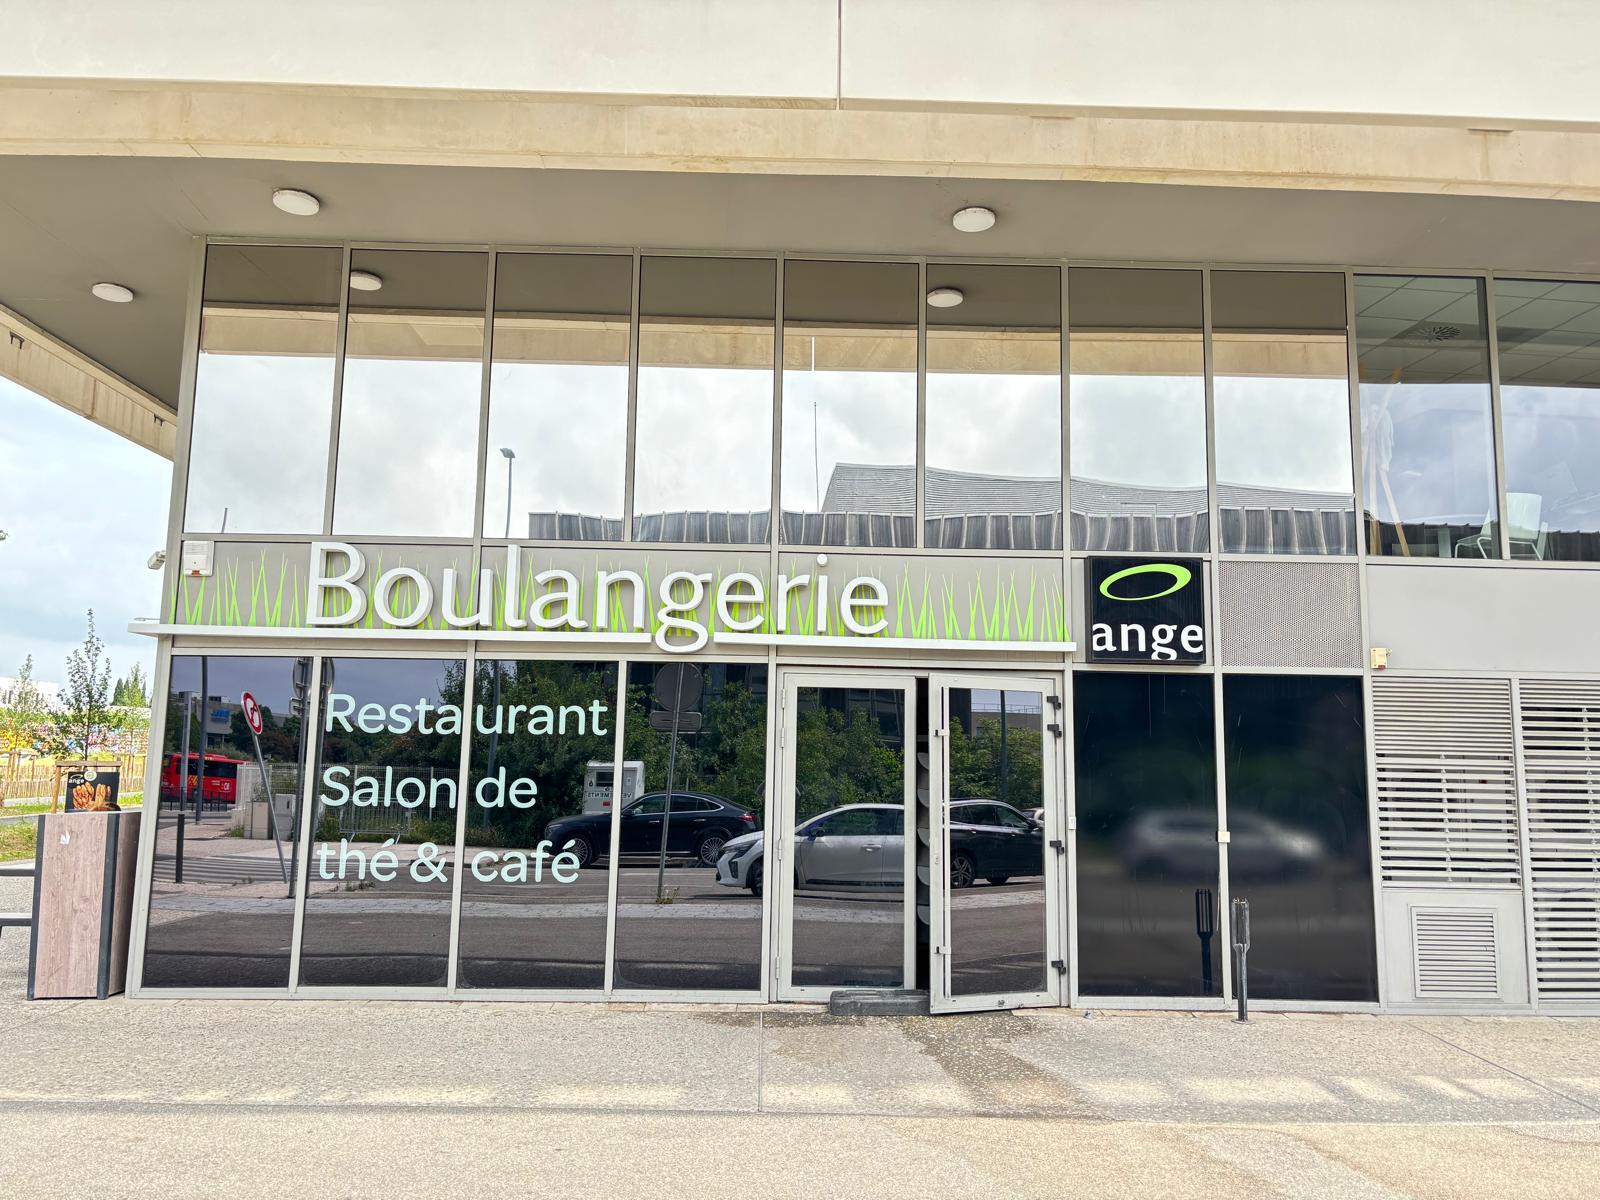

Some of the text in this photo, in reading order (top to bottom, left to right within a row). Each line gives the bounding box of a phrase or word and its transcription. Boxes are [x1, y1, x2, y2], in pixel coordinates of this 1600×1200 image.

[306, 541, 889, 653] Boulangerie
[1092, 623, 1204, 660] ange
[325, 693, 609, 736] Restaurant
[320, 766, 538, 809] Salon de
[317, 838, 580, 884] thé & café
